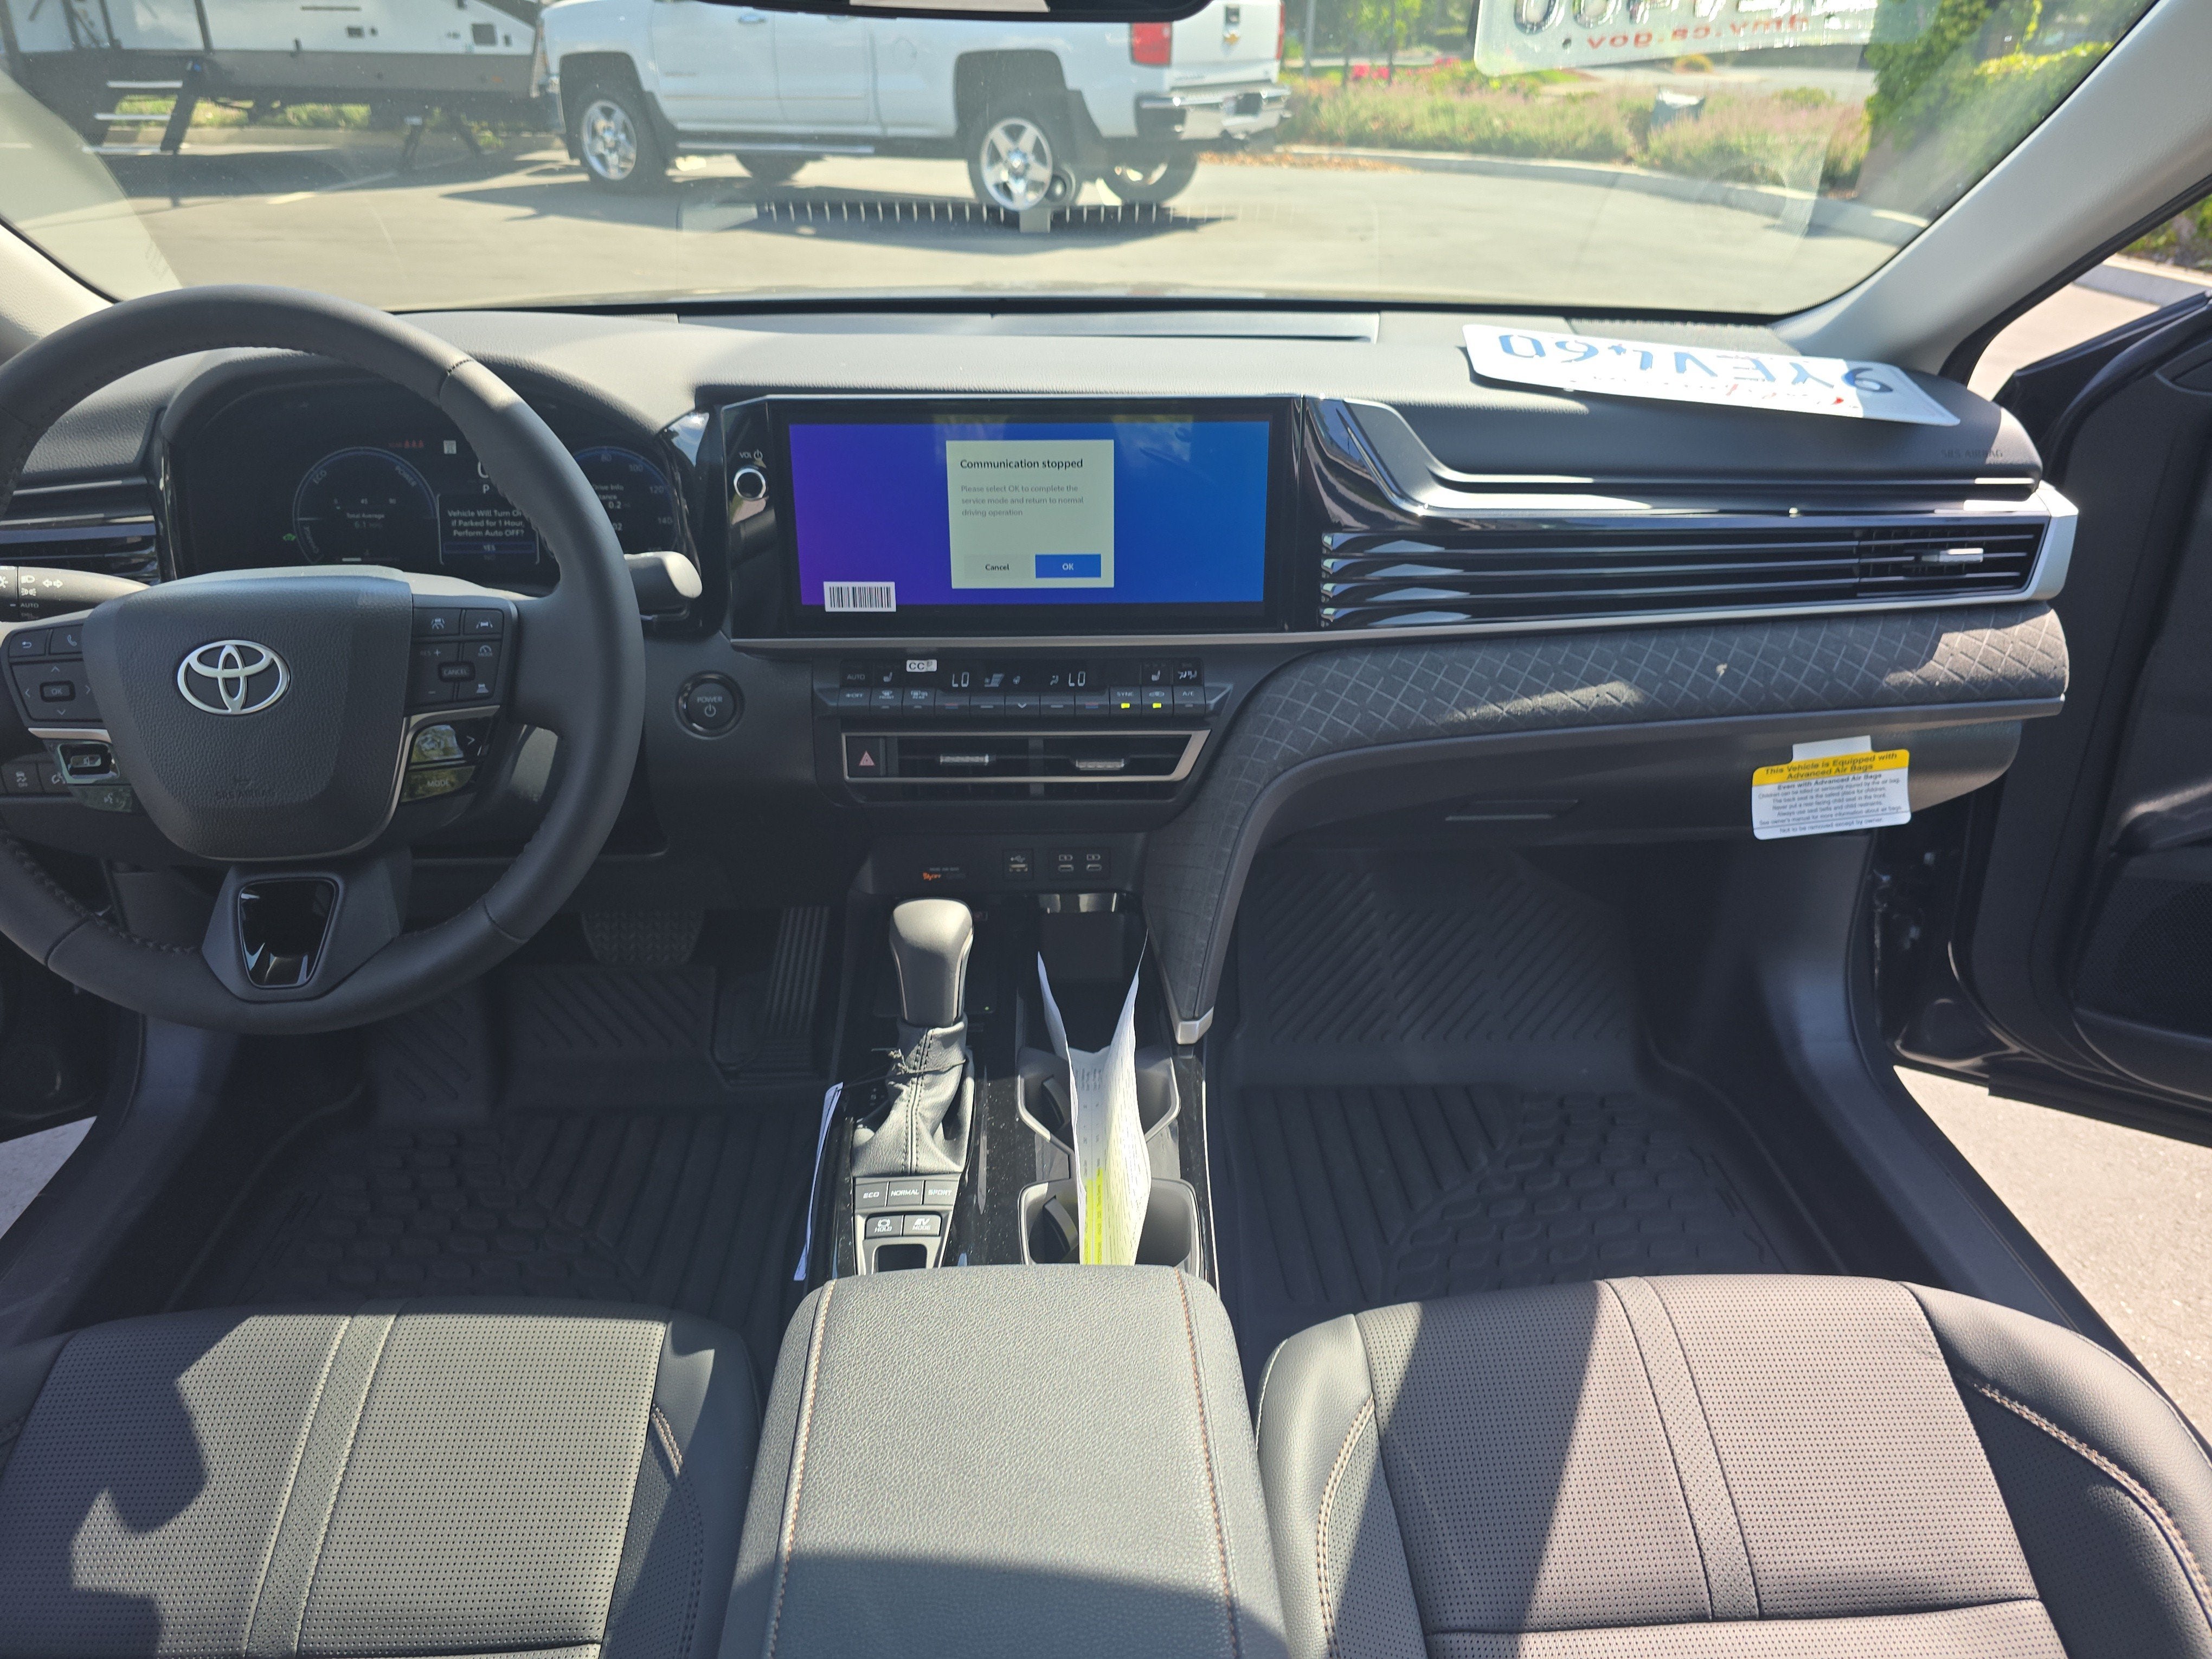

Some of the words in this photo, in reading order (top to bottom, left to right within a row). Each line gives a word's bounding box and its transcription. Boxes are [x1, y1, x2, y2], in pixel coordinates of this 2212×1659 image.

[960, 459, 1039, 470] Communication
[1041, 459, 1083, 471] stopped
[483, 484, 490, 494] P
[1031, 485, 1064, 494] complete
[962, 509, 986, 517] driving
[988, 509, 1023, 517] operation
[952, 672, 969, 687] LO
[1068, 671, 1086, 687] LO
[51, 687, 63, 696] OK
[1787, 762, 1819, 772] Vehicle
[1832, 755, 1875, 768] Equipped
[1879, 753, 1897, 761] with
[1787, 769, 1831, 780] Advanced
[1850, 763, 1873, 773] Bags
[427, 780, 450, 788] MODE
[1814, 776, 1849, 786] Advanced
[891, 1189, 919, 1197] NORMAL
